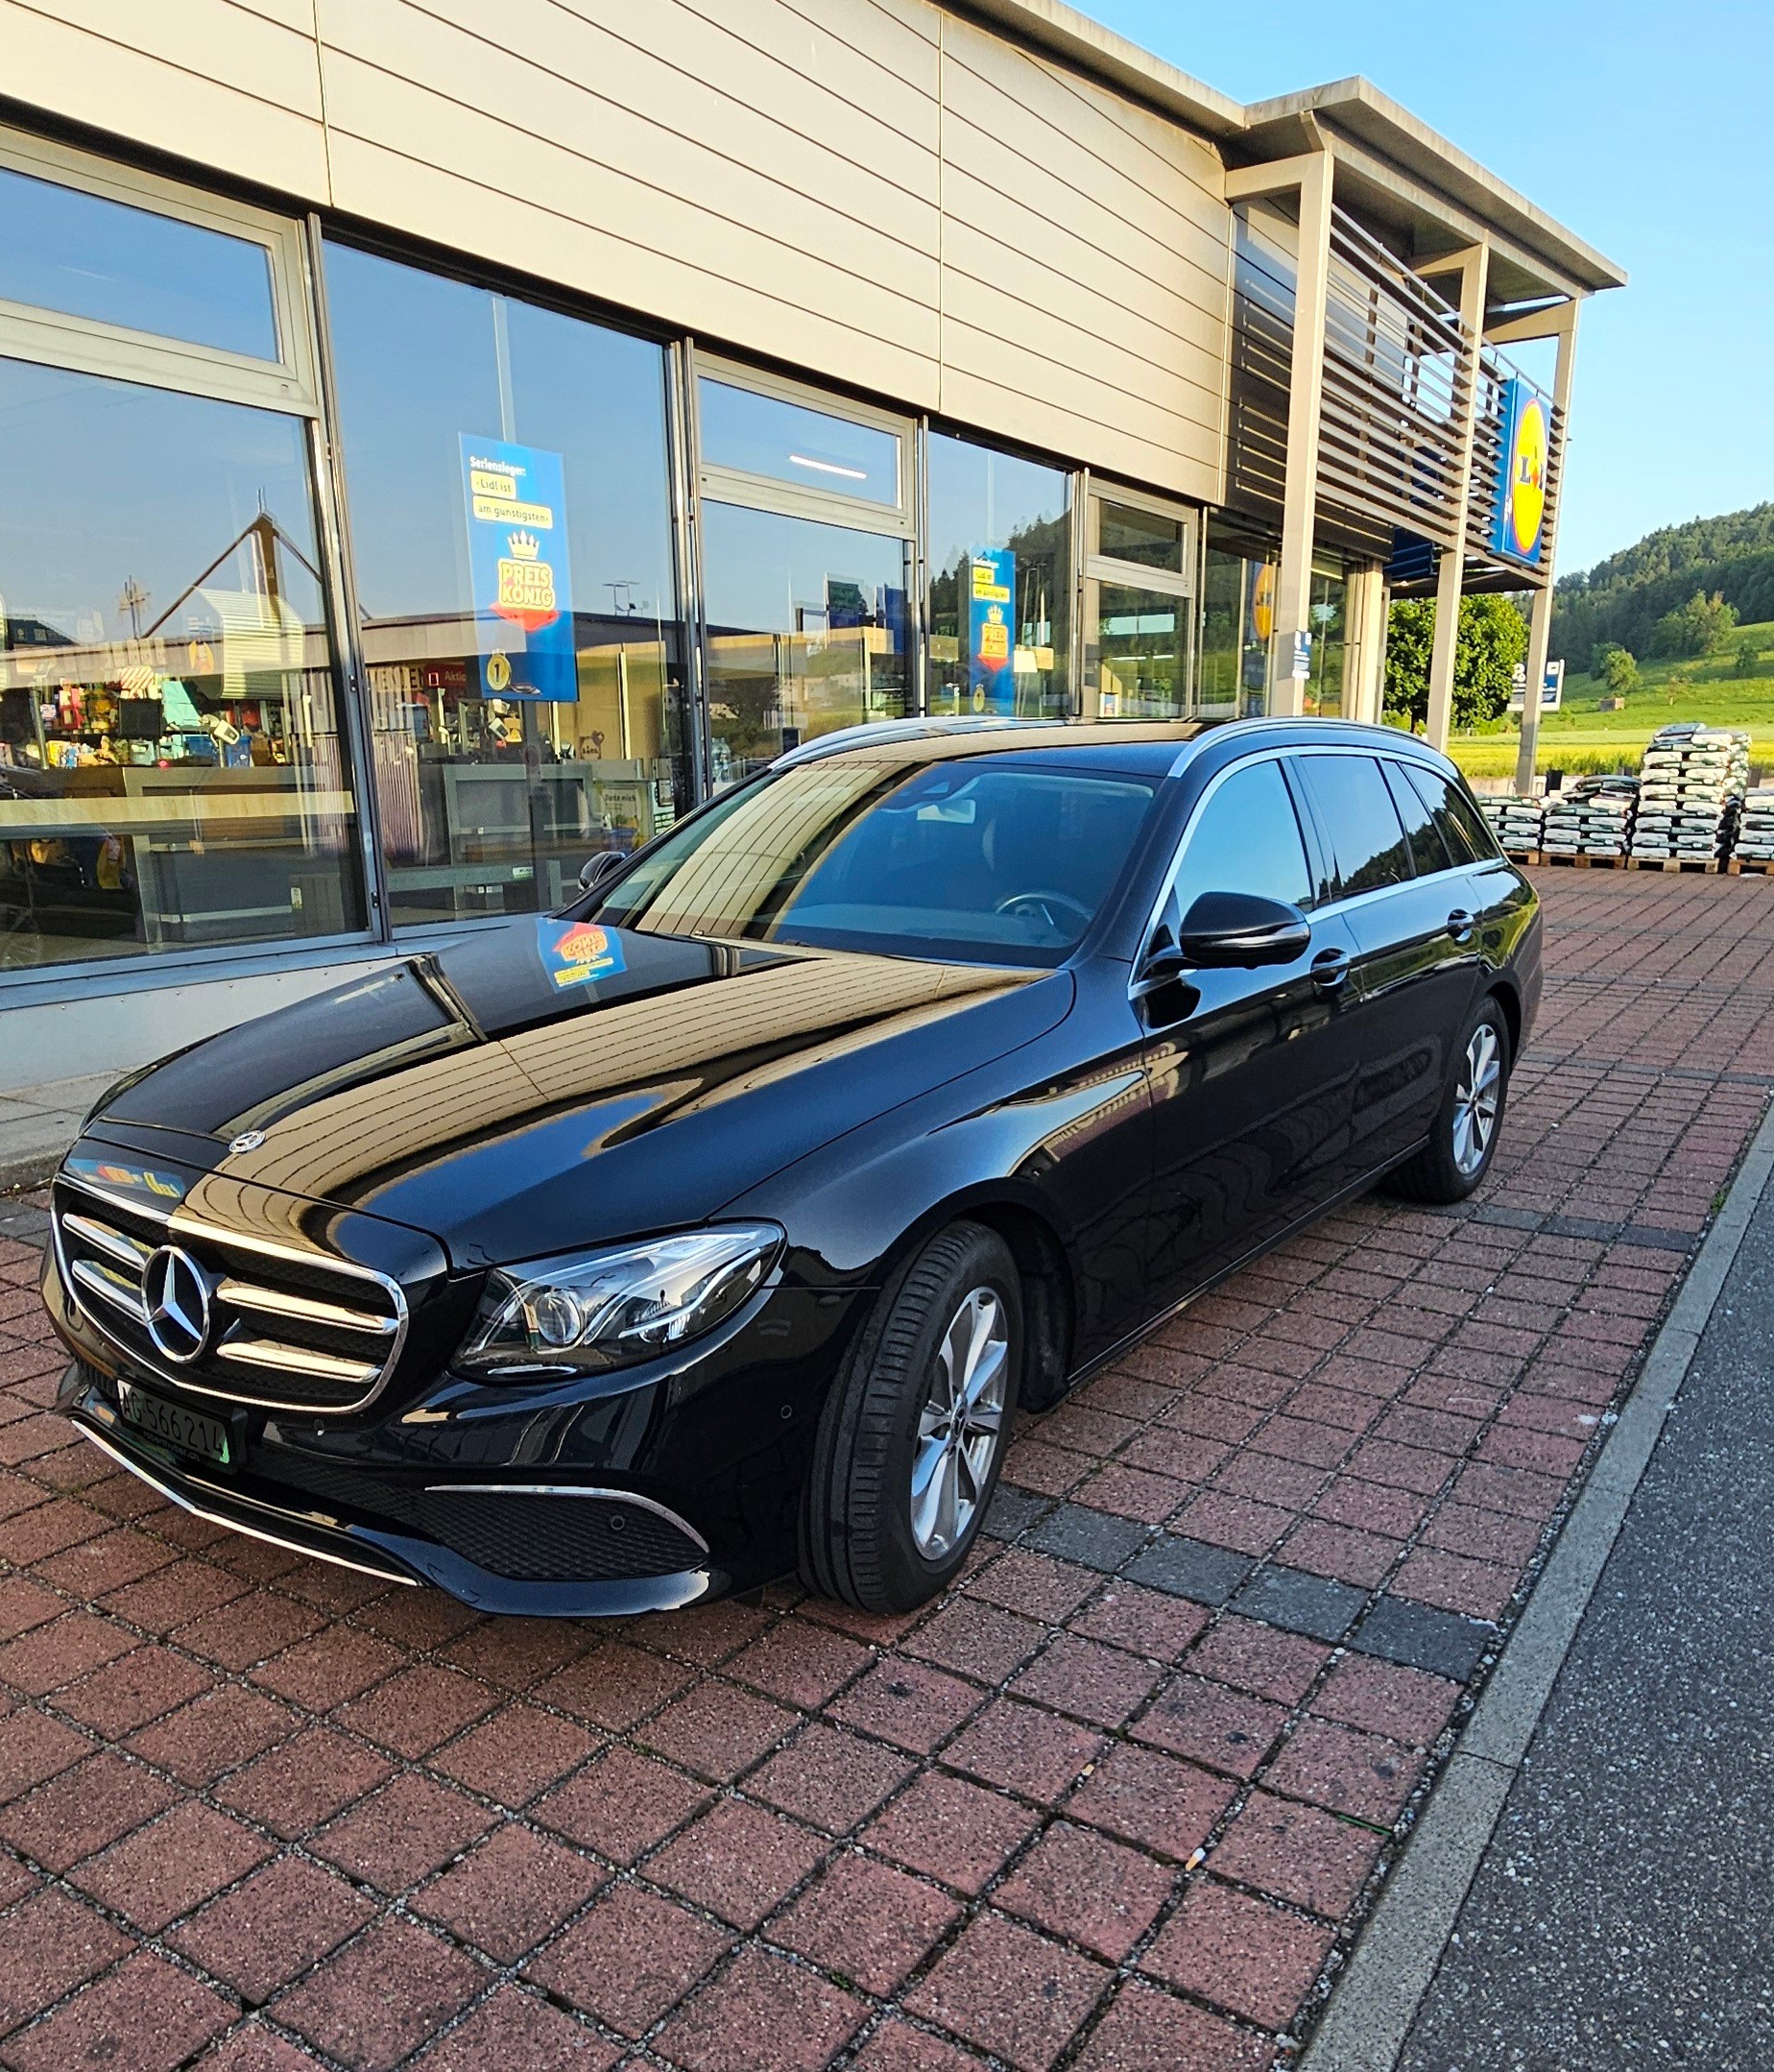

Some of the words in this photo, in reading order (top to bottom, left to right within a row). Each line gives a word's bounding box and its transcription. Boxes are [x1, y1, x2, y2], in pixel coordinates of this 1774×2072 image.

[500, 482, 512, 493] ist
[478, 505, 491, 514] am
[501, 563, 550, 589] PREIS
[494, 662, 500, 683] 1
[121, 1385, 143, 1422] AG
